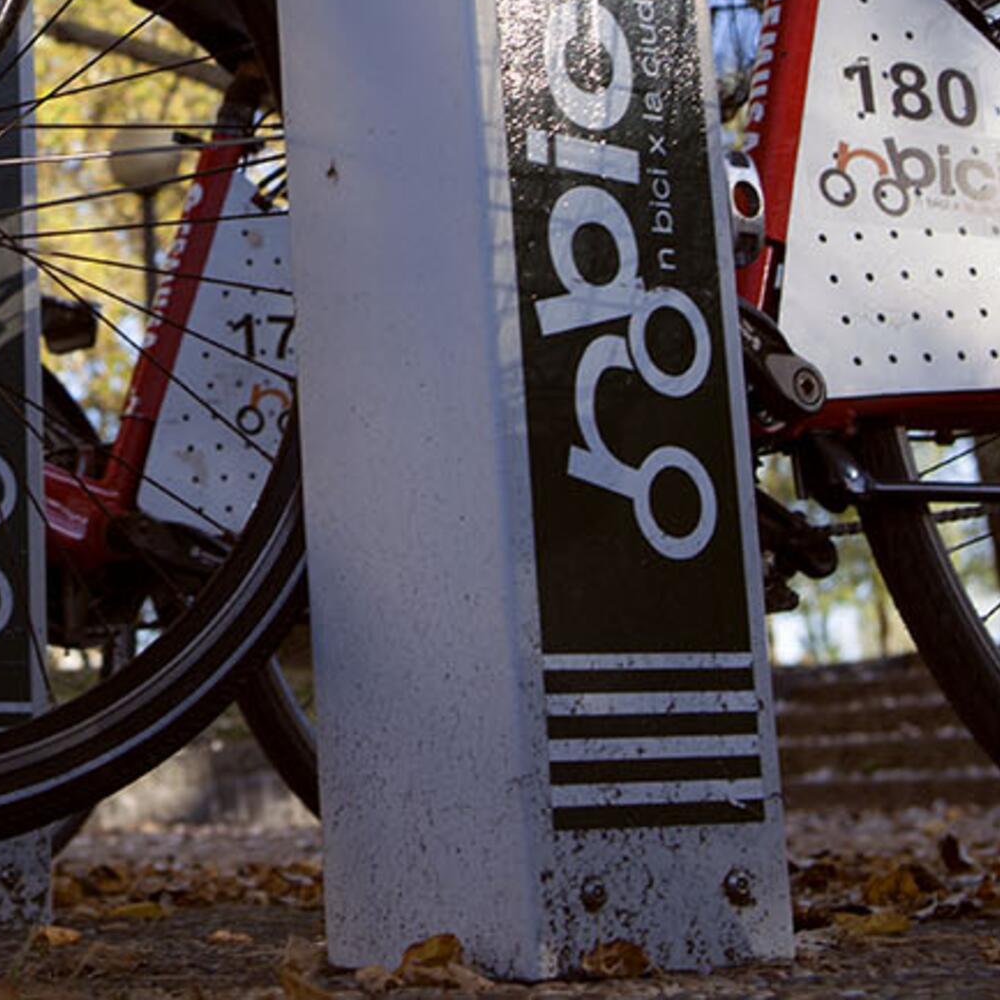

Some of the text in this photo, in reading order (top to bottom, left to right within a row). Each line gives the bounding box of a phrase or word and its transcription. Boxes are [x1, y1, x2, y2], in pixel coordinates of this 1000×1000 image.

[640, 91, 664, 123] la
[843, 61, 977, 127] 180
[648, 133, 667, 156] x
[645, 167, 674, 234] bici
[655, 247, 677, 272] n
